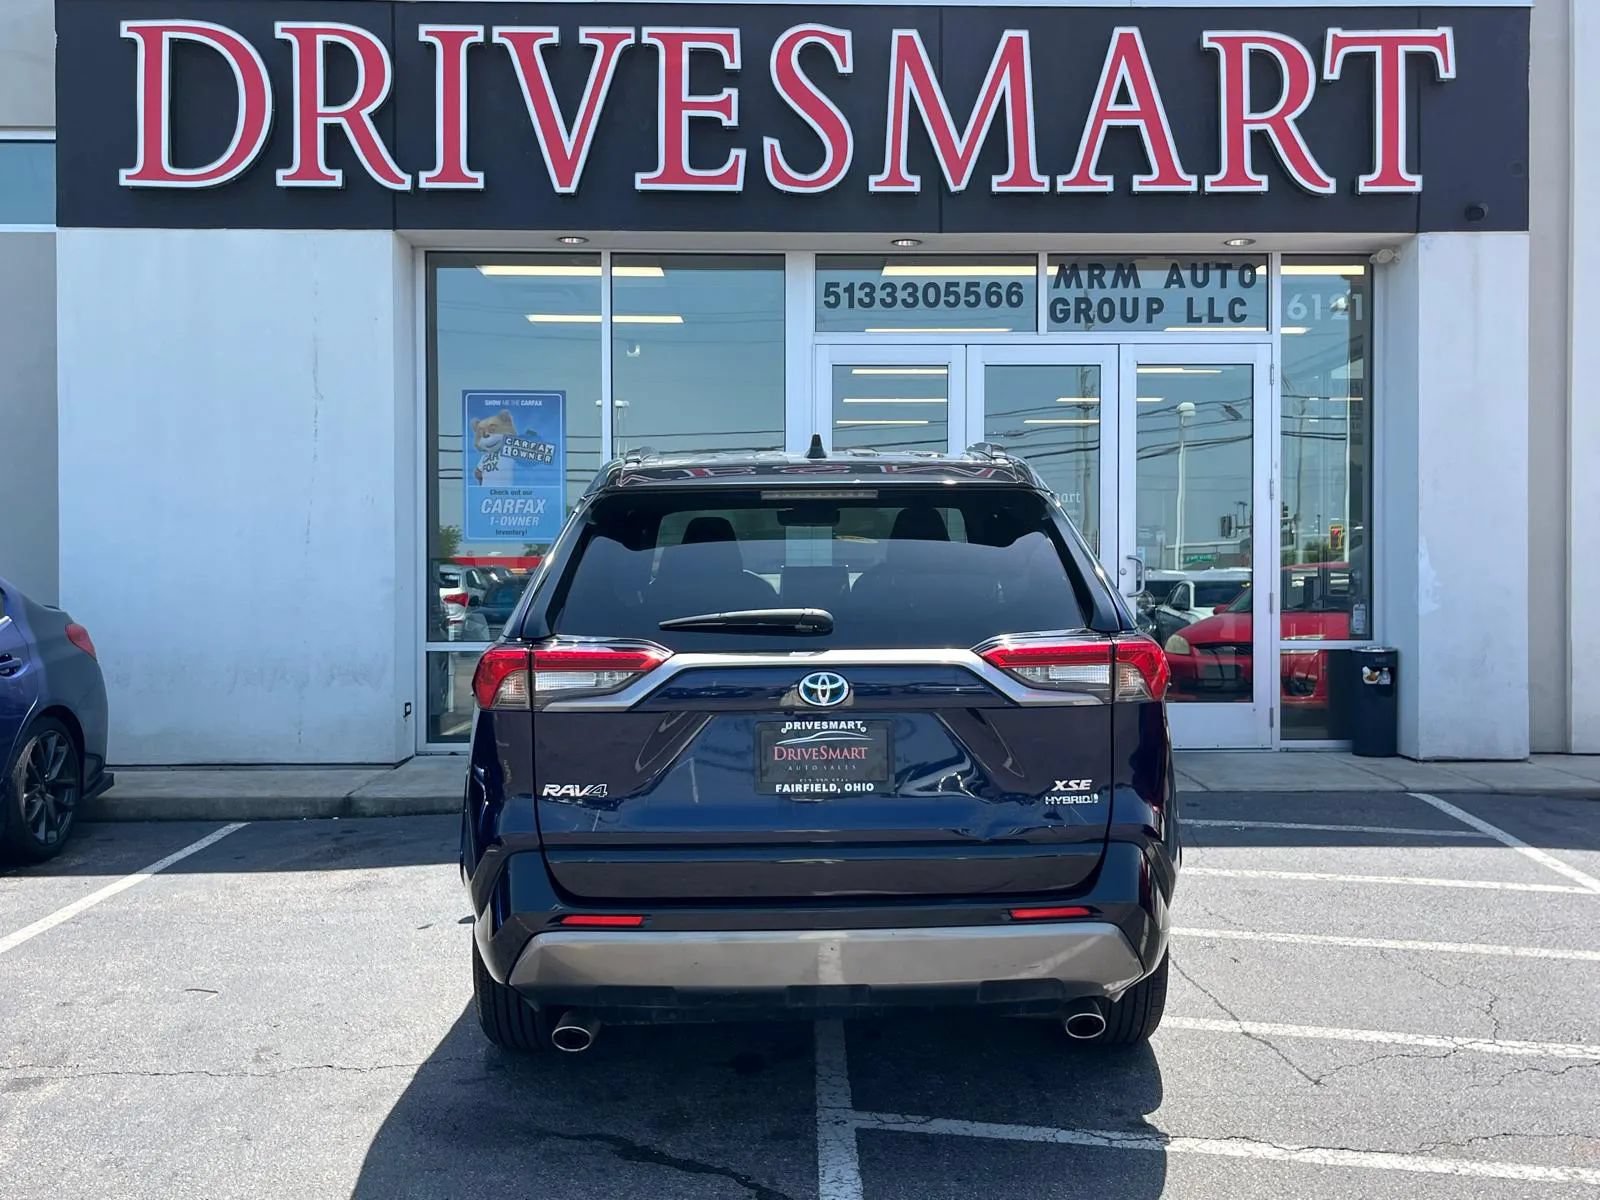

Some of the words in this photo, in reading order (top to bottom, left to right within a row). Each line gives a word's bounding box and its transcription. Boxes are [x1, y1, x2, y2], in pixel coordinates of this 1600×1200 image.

[119, 19, 1457, 195] DRIVESMART
[1053, 263, 1142, 289] MRM
[1163, 263, 1257, 289] AUTO
[823, 281, 1025, 311] 5133305566
[1049, 297, 1165, 324] GROUP
[1186, 297, 1248, 323] LLC
[1287, 294, 1364, 321] 6121
[505, 438, 555, 454] CARFAX
[481, 498, 546, 514] CARFAX
[489, 516, 540, 527] 1-OWNER
[785, 720, 864, 730] DRIVESMART
[542, 783, 608, 798] RAV4
[775, 783, 840, 794] FAIRFIELD,
[844, 783, 875, 793] OHIO
[1051, 779, 1093, 791] XSE
[1045, 794, 1092, 805] HYBRID
